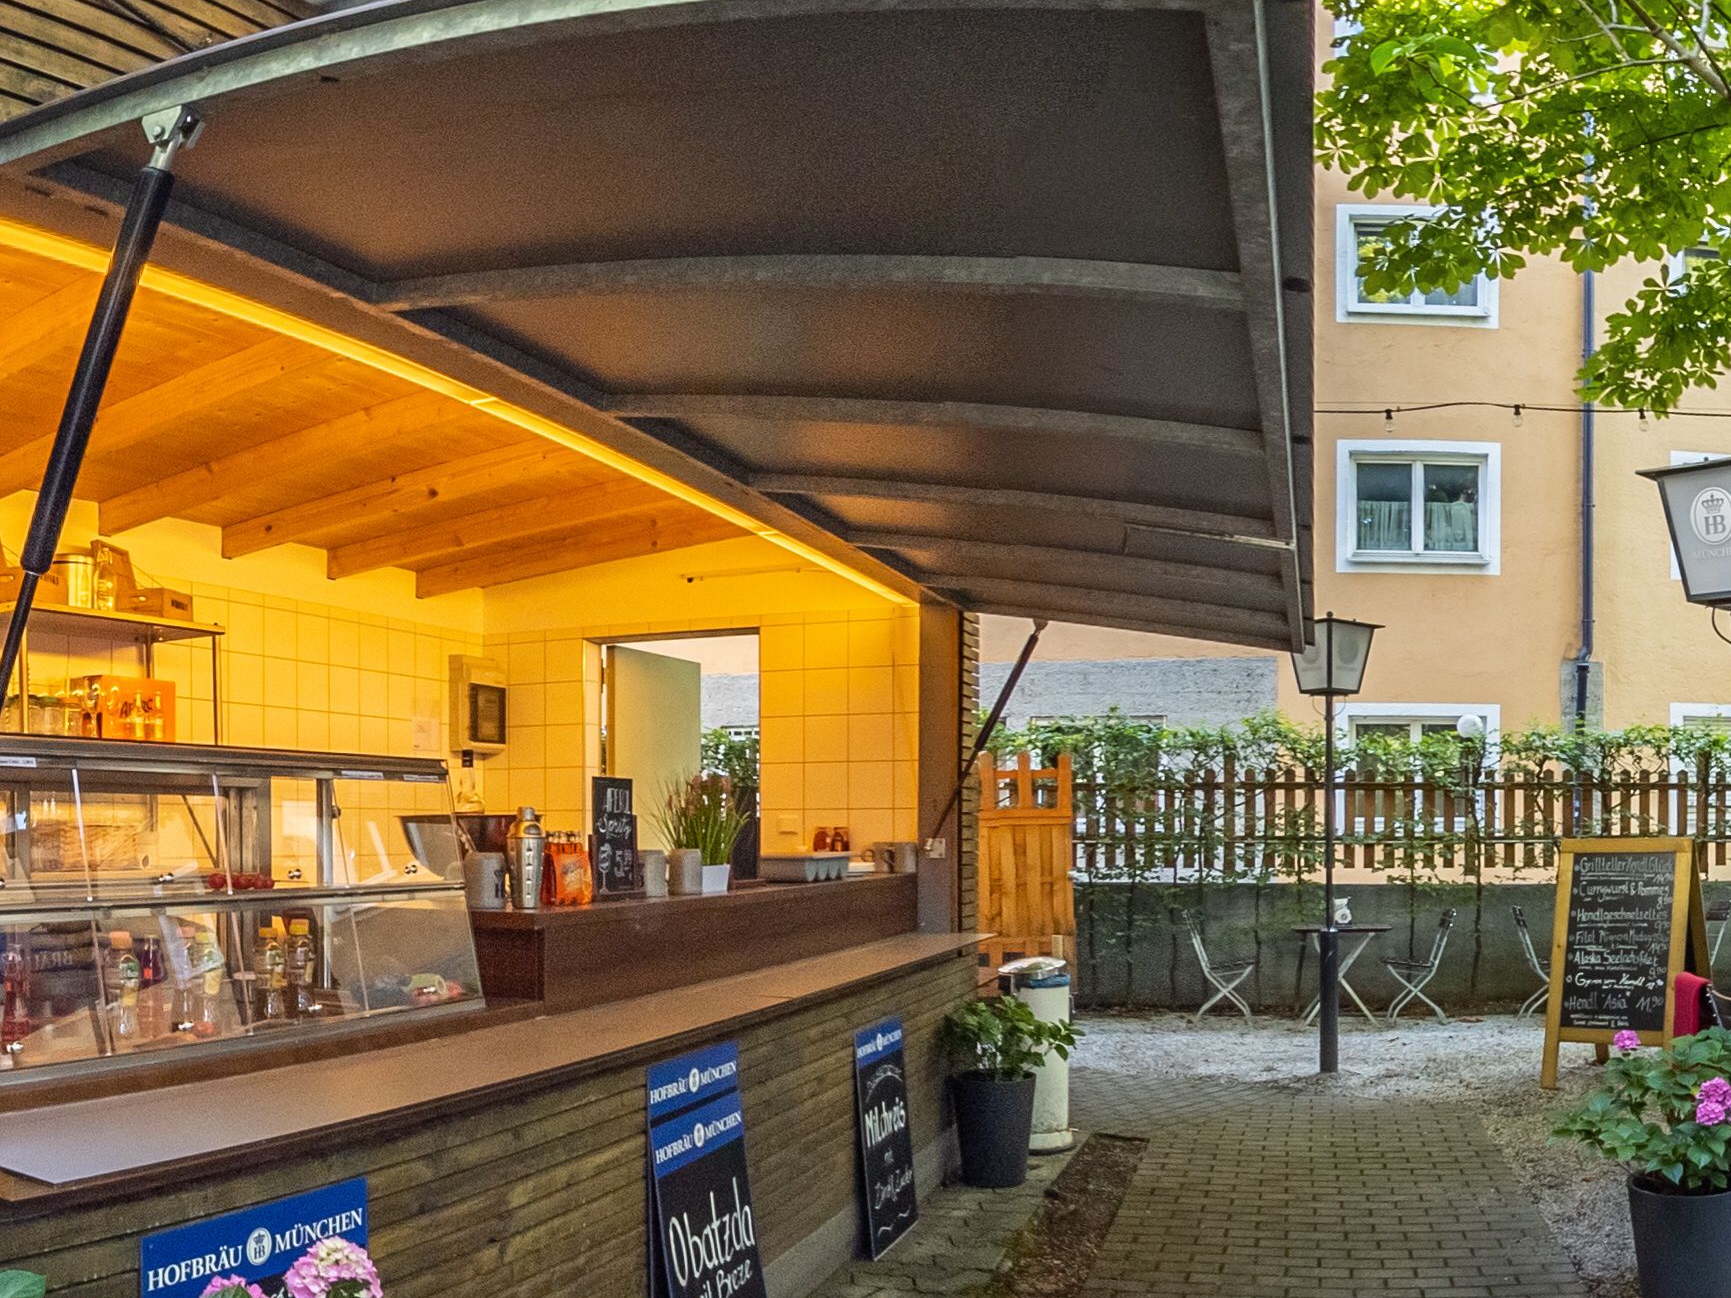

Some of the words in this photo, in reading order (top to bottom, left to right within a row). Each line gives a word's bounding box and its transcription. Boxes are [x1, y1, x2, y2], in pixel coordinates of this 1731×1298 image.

[1704, 514, 1727, 536] HB
[1569, 991, 1598, 1010] Hendl
[700, 1060, 737, 1086] MÜNCHEN
[704, 1111, 742, 1141] MÜNCHEN
[669, 1177, 756, 1288] Obatzda
[147, 1245, 243, 1292] HOFBRÄU
[253, 1245, 266, 1260] HB
[274, 1208, 364, 1254] MÜNCHEN
